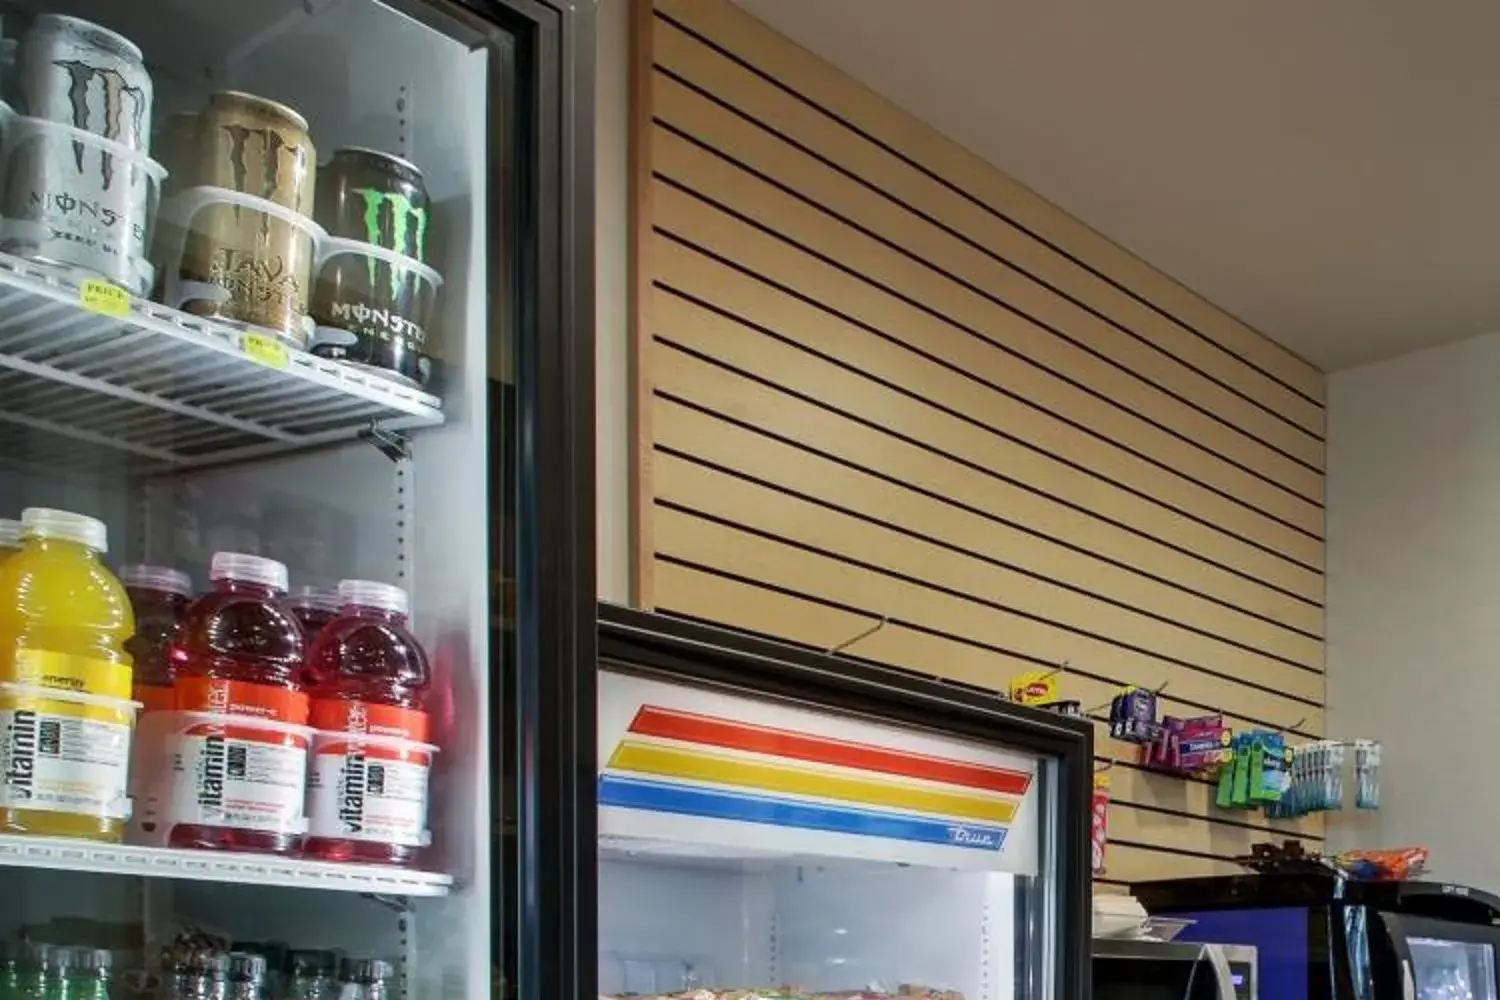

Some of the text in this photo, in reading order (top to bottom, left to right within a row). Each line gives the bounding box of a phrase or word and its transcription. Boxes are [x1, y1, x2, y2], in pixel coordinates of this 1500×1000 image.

[331, 302, 426, 345] MONSTE
[6, 708, 37, 799] vitamin
[197, 734, 226, 818] vitamin
[338, 755, 366, 834] vitamin
